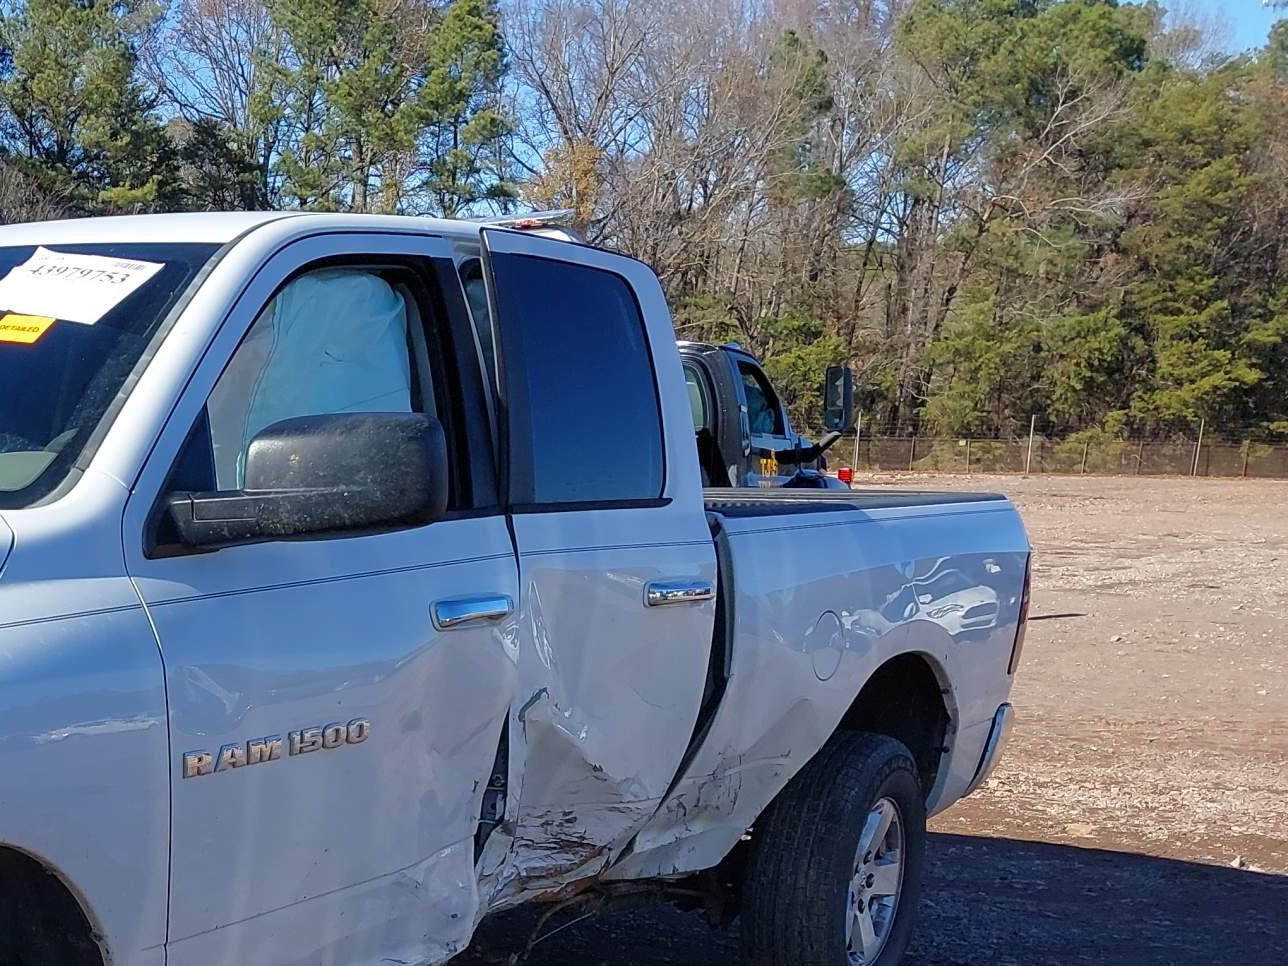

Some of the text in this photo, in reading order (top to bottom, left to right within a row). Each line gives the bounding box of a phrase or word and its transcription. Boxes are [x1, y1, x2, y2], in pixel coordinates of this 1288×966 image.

[29, 264, 132, 284] 43979753
[182, 716, 371, 779] RAM 1500
